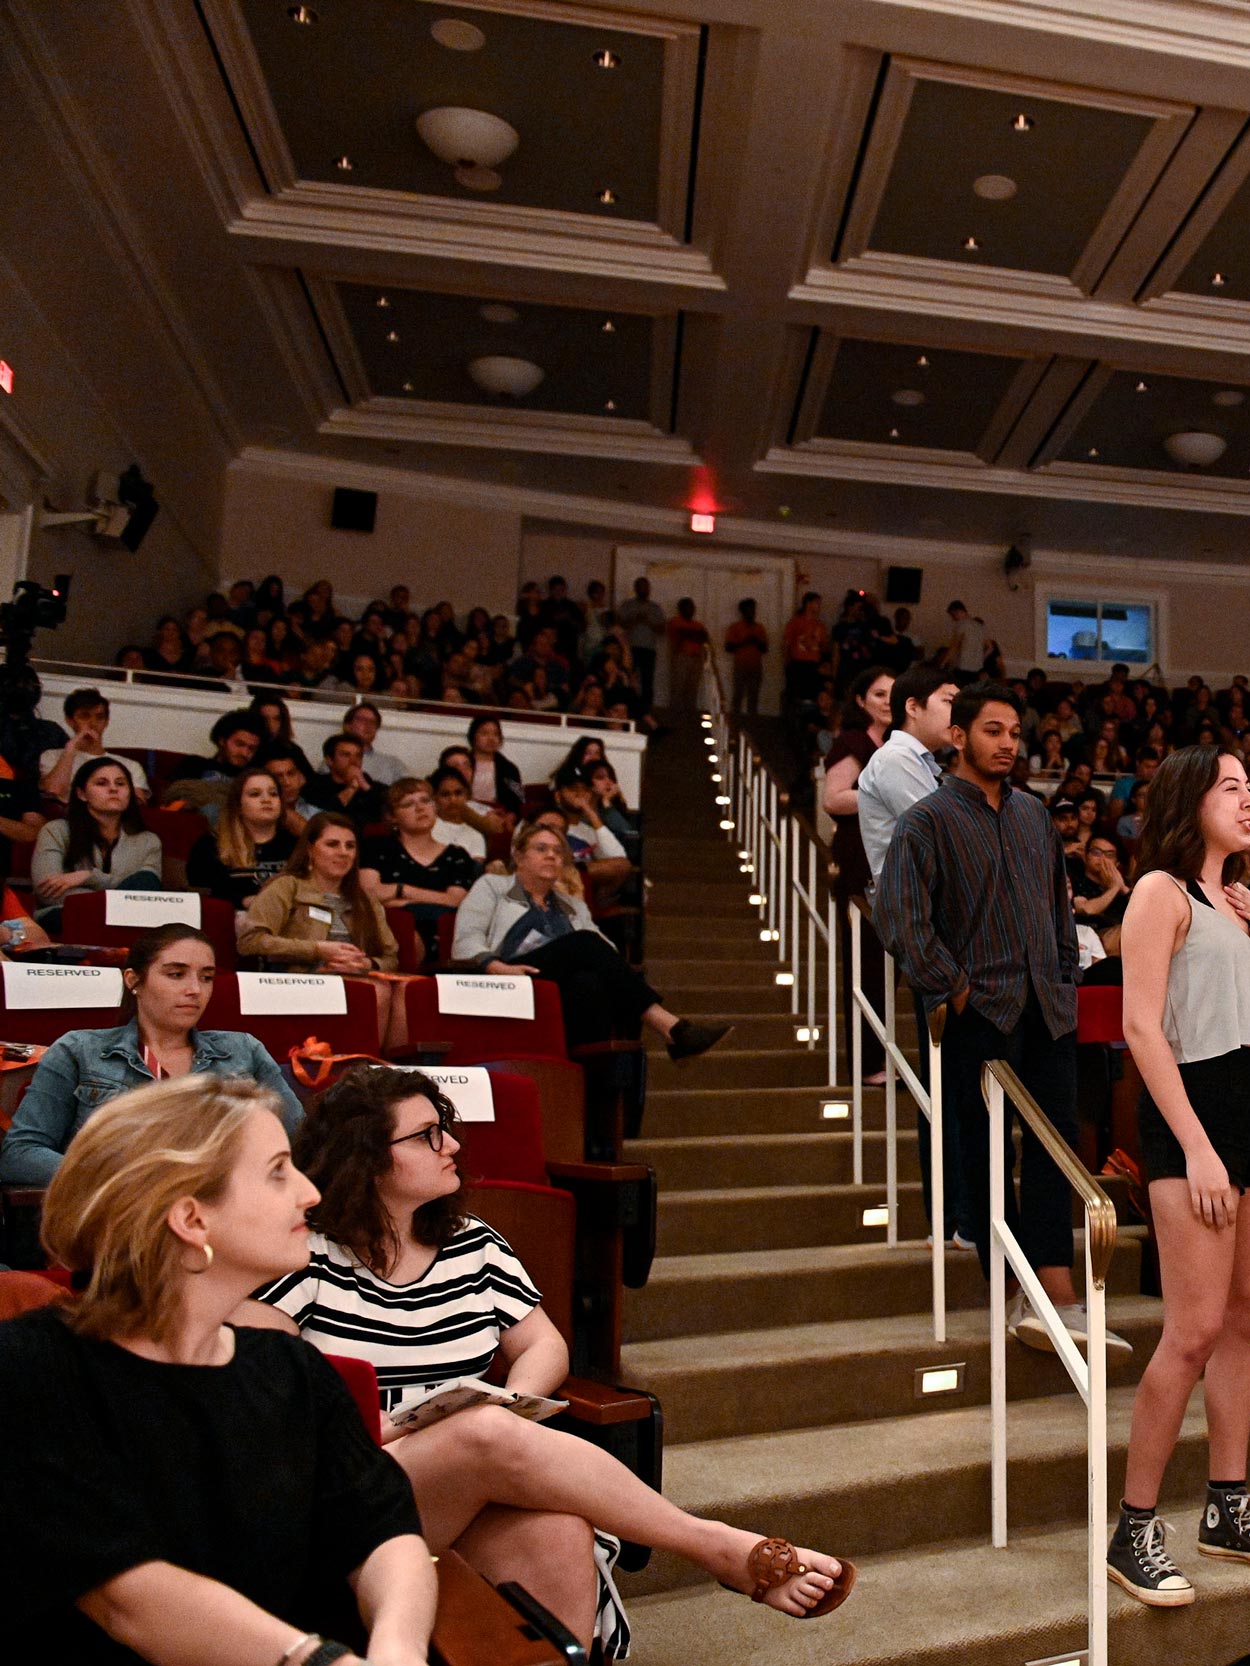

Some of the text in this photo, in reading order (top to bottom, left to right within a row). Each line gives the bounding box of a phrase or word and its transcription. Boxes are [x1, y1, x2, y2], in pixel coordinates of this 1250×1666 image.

[124, 894, 184, 904] RESERVED
[26, 968, 101, 977] RESERVED
[258, 977, 325, 986] RESERVED
[455, 979, 516, 991] RESERVED
